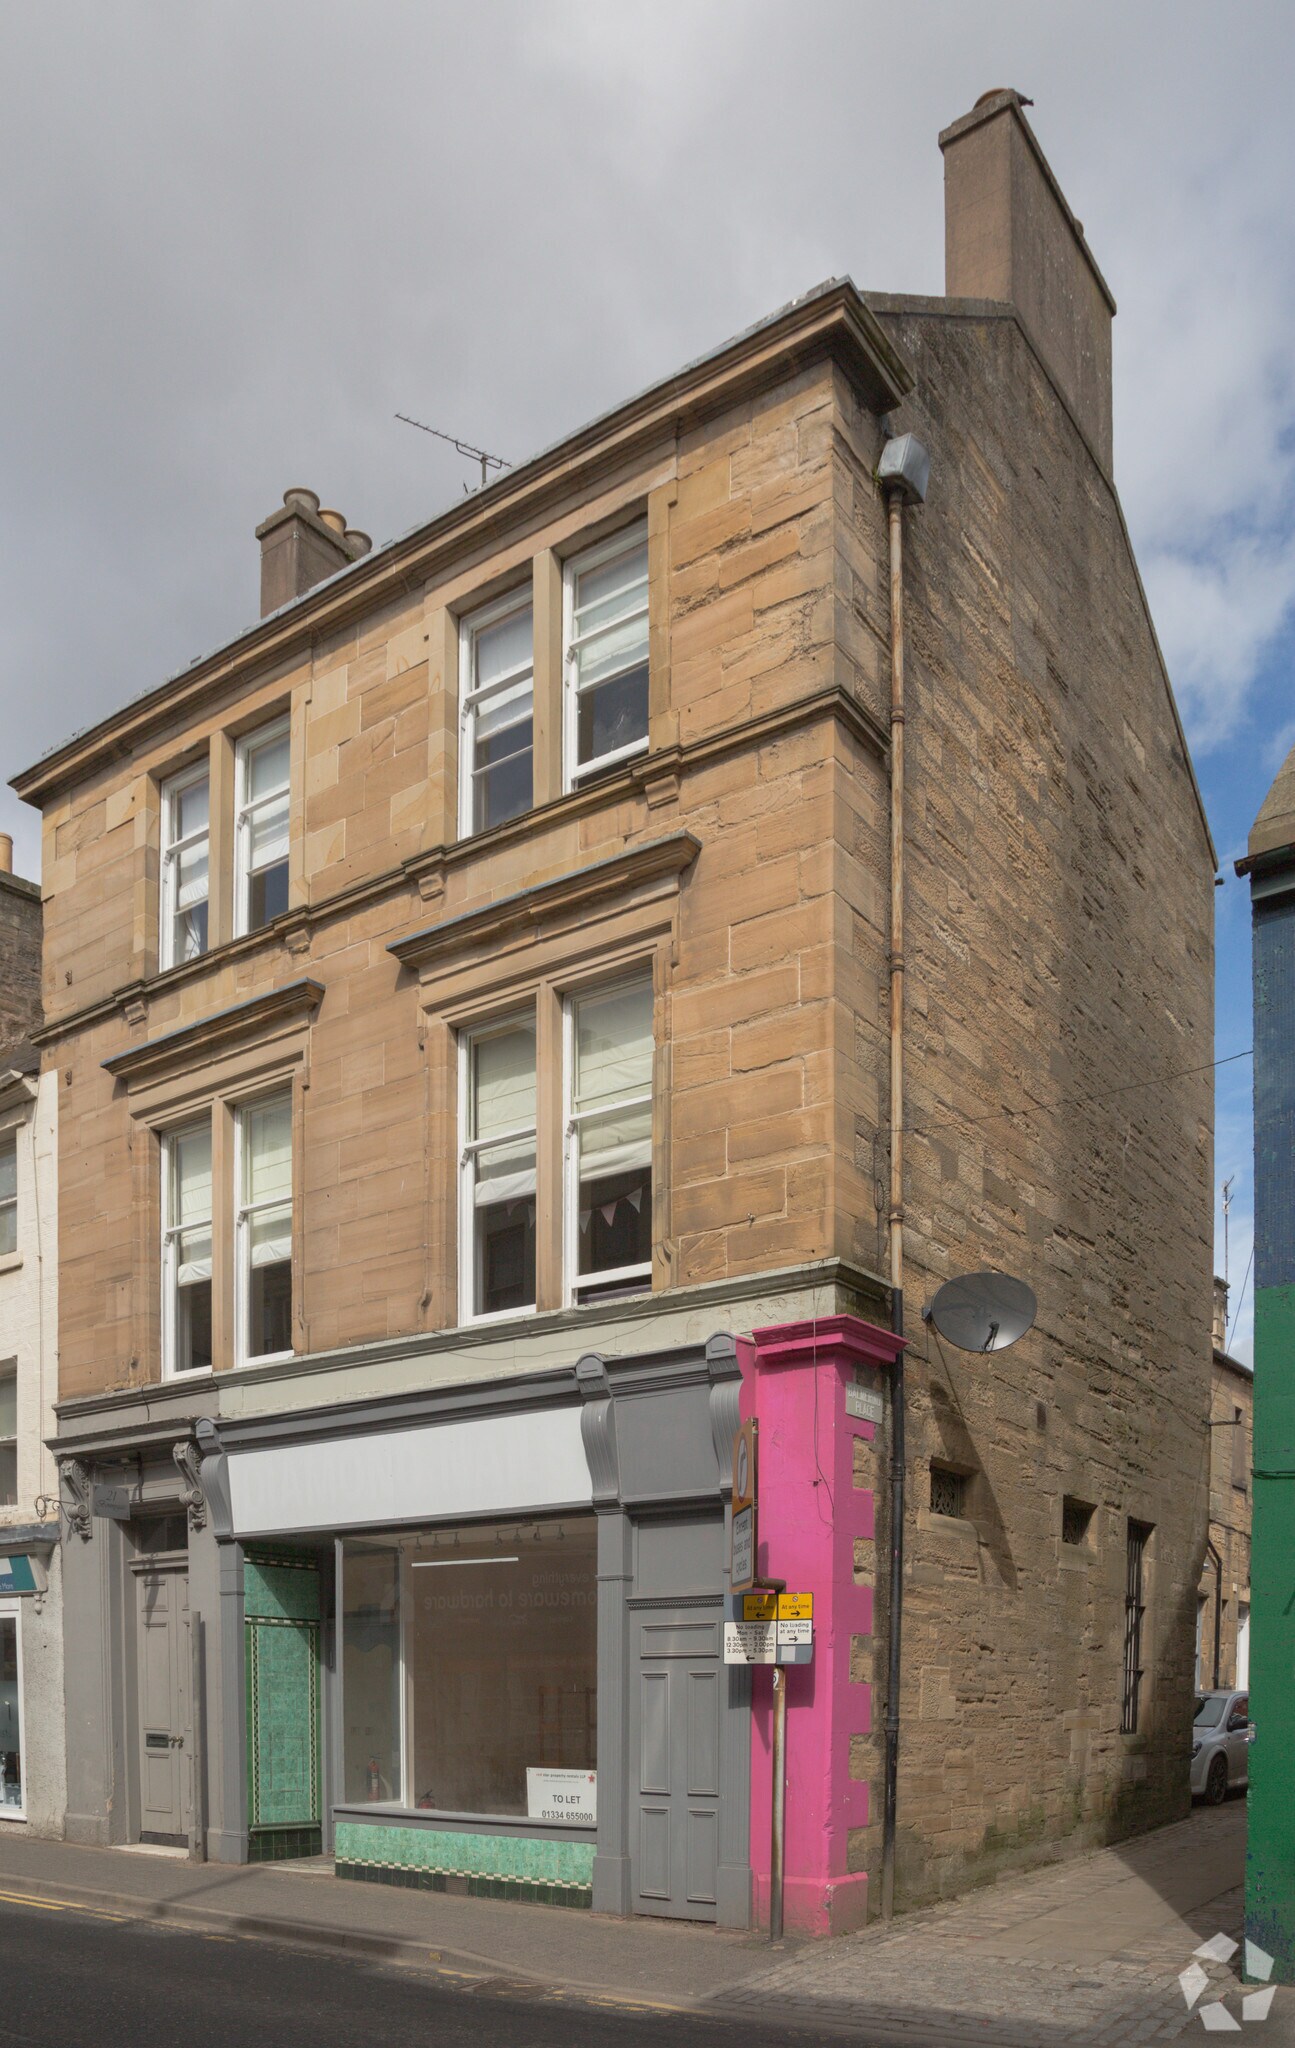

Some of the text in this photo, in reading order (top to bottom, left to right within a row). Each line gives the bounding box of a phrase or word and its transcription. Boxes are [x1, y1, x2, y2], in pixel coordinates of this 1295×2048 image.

[855, 1400, 874, 1417] PLACE
[243, 1437, 423, 1513] DIAMOND
[105, 1490, 117, 1501] 21
[736, 1517, 748, 1535] Except
[736, 1558, 747, 1576] cycles
[552, 1794, 581, 1804] TO LET
[541, 1810, 593, 1821] 01334 655000
